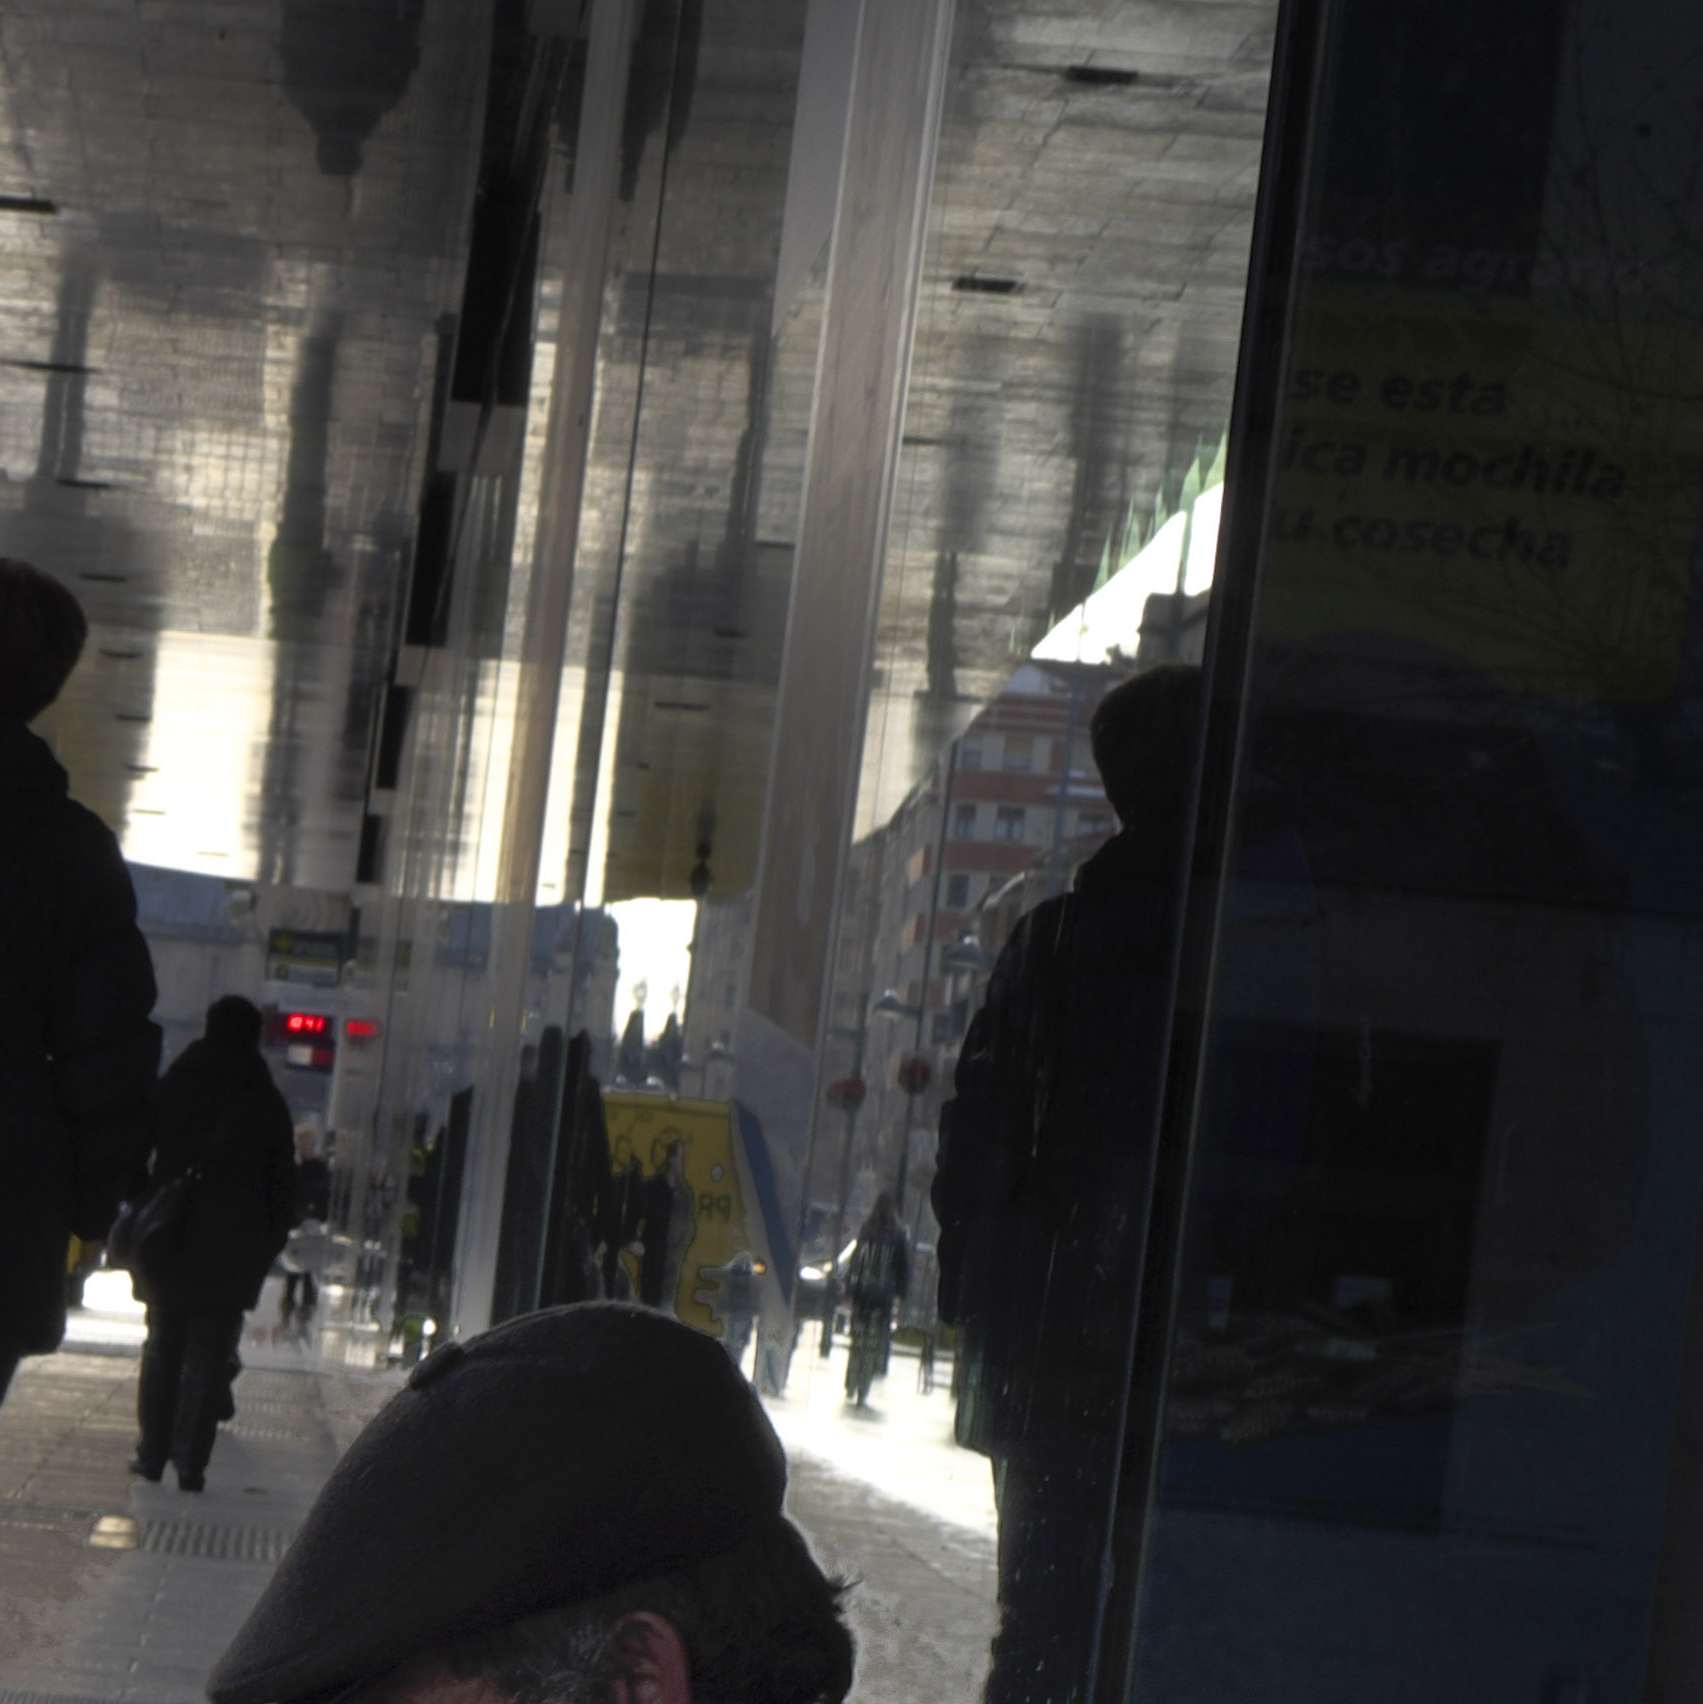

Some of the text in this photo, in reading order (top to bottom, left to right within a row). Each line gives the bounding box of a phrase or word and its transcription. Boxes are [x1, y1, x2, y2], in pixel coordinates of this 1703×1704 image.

[1379, 372, 1507, 417] esta
[1383, 445, 1627, 500] mochila
[1332, 515, 1573, 568] cosecha
